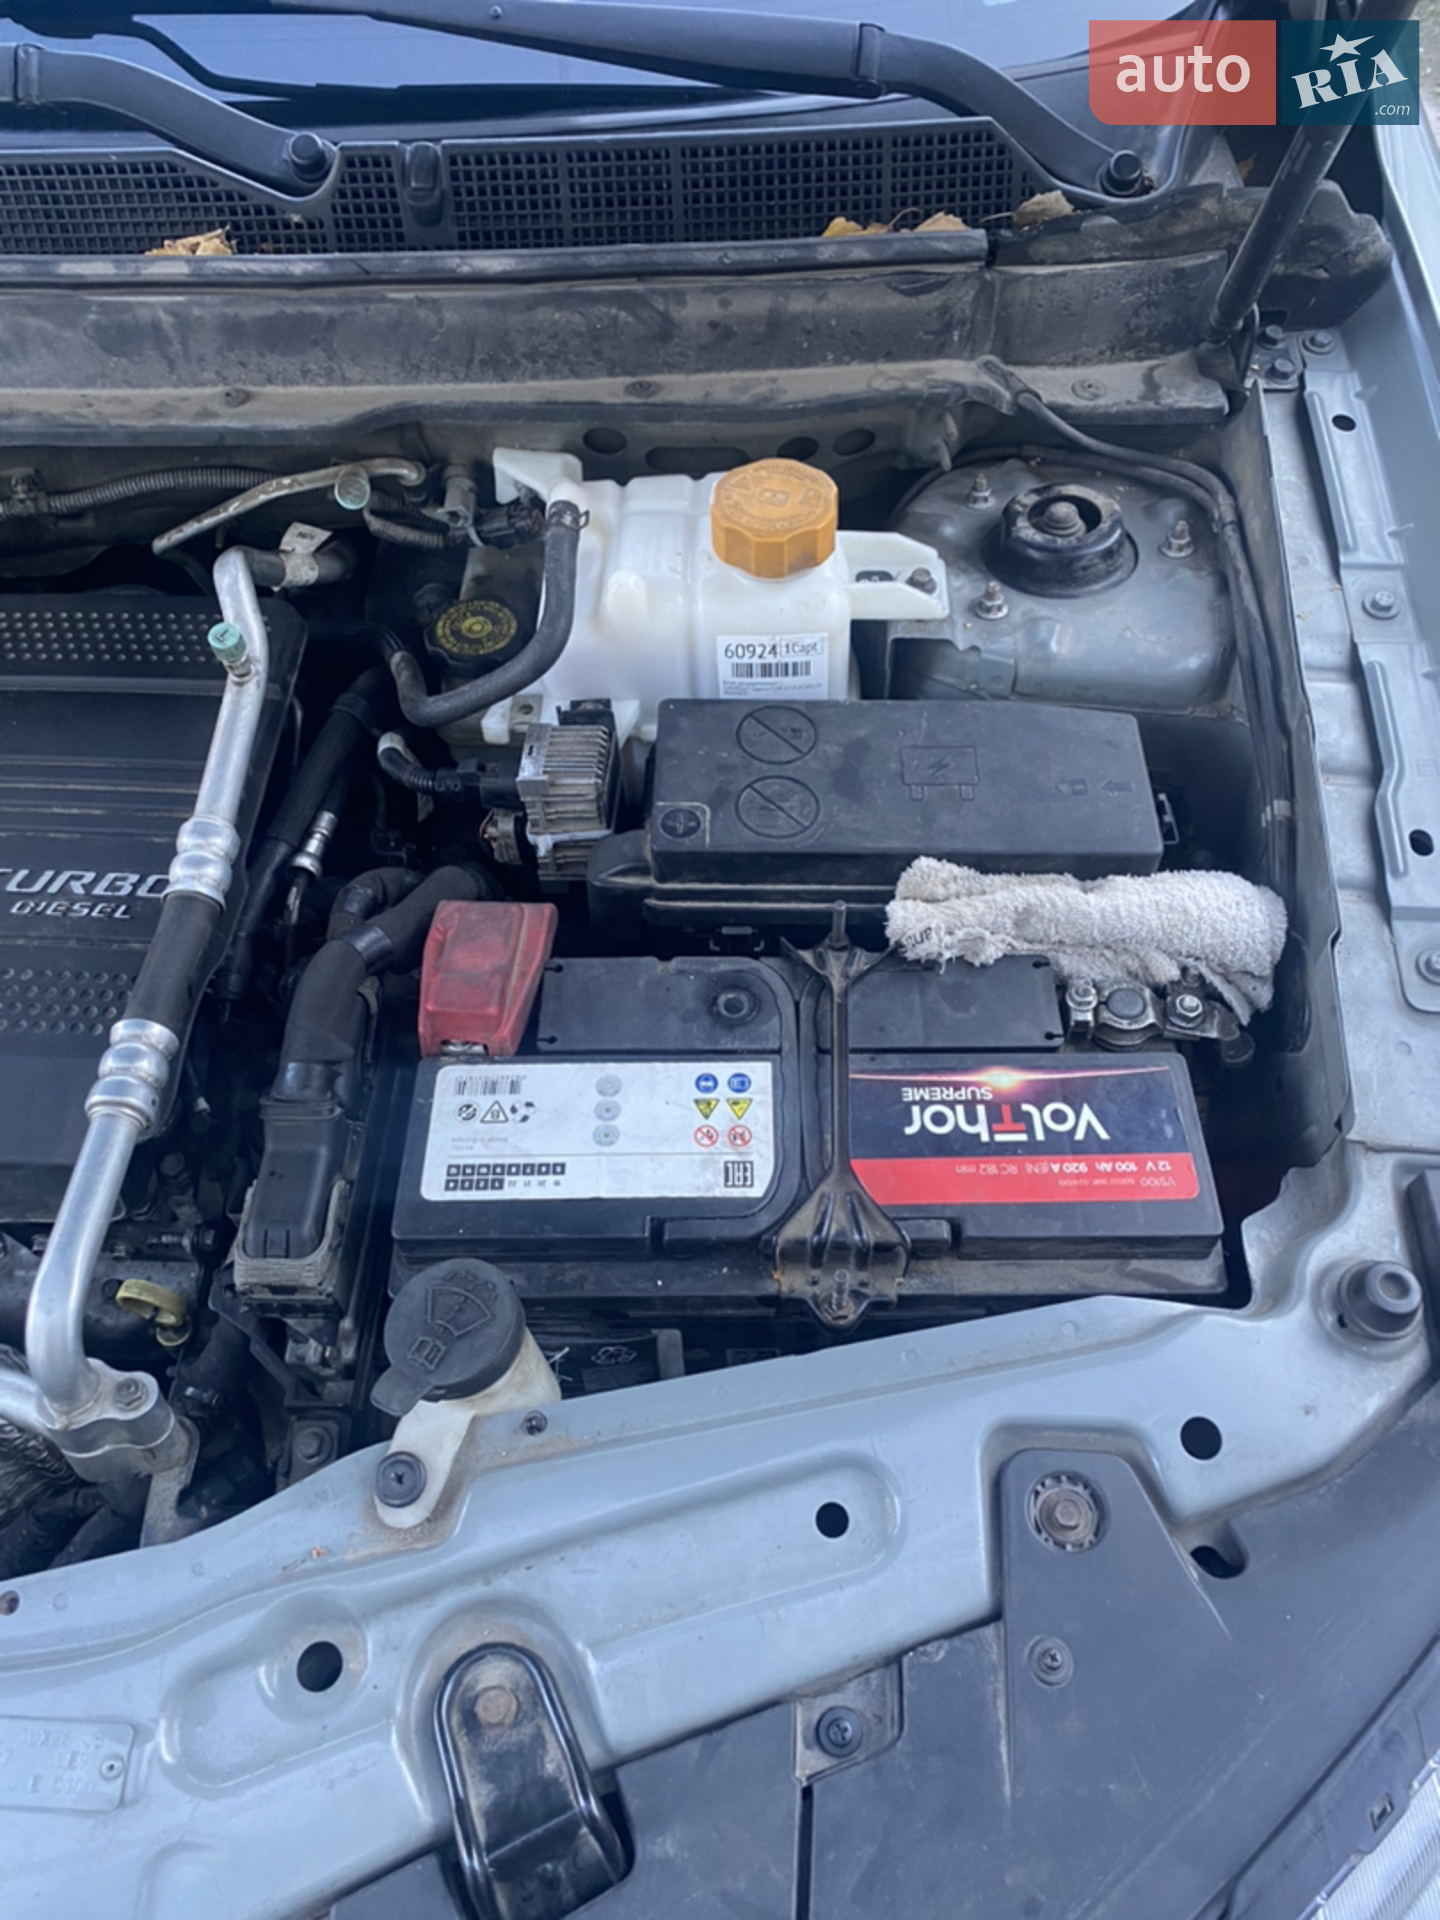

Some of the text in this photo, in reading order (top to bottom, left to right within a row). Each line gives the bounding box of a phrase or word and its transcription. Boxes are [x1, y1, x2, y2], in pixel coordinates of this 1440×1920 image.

[724, 643, 778, 659] 60924
[10, 899, 131, 919] DIESEL
[902, 1086, 993, 1101] SUPREME
[956, 1164, 977, 1174] min
[979, 1163, 998, 1174] 182
[1000, 1163, 1018, 1174] RC
[1050, 1162, 1061, 1173] A
[1063, 1162, 1088, 1173] 920
[1095, 1162, 1113, 1172] Ah
[1115, 1162, 1138, 1172] 100
[1146, 1161, 1157, 1172] V
[1158, 1161, 1172, 1171] 12
